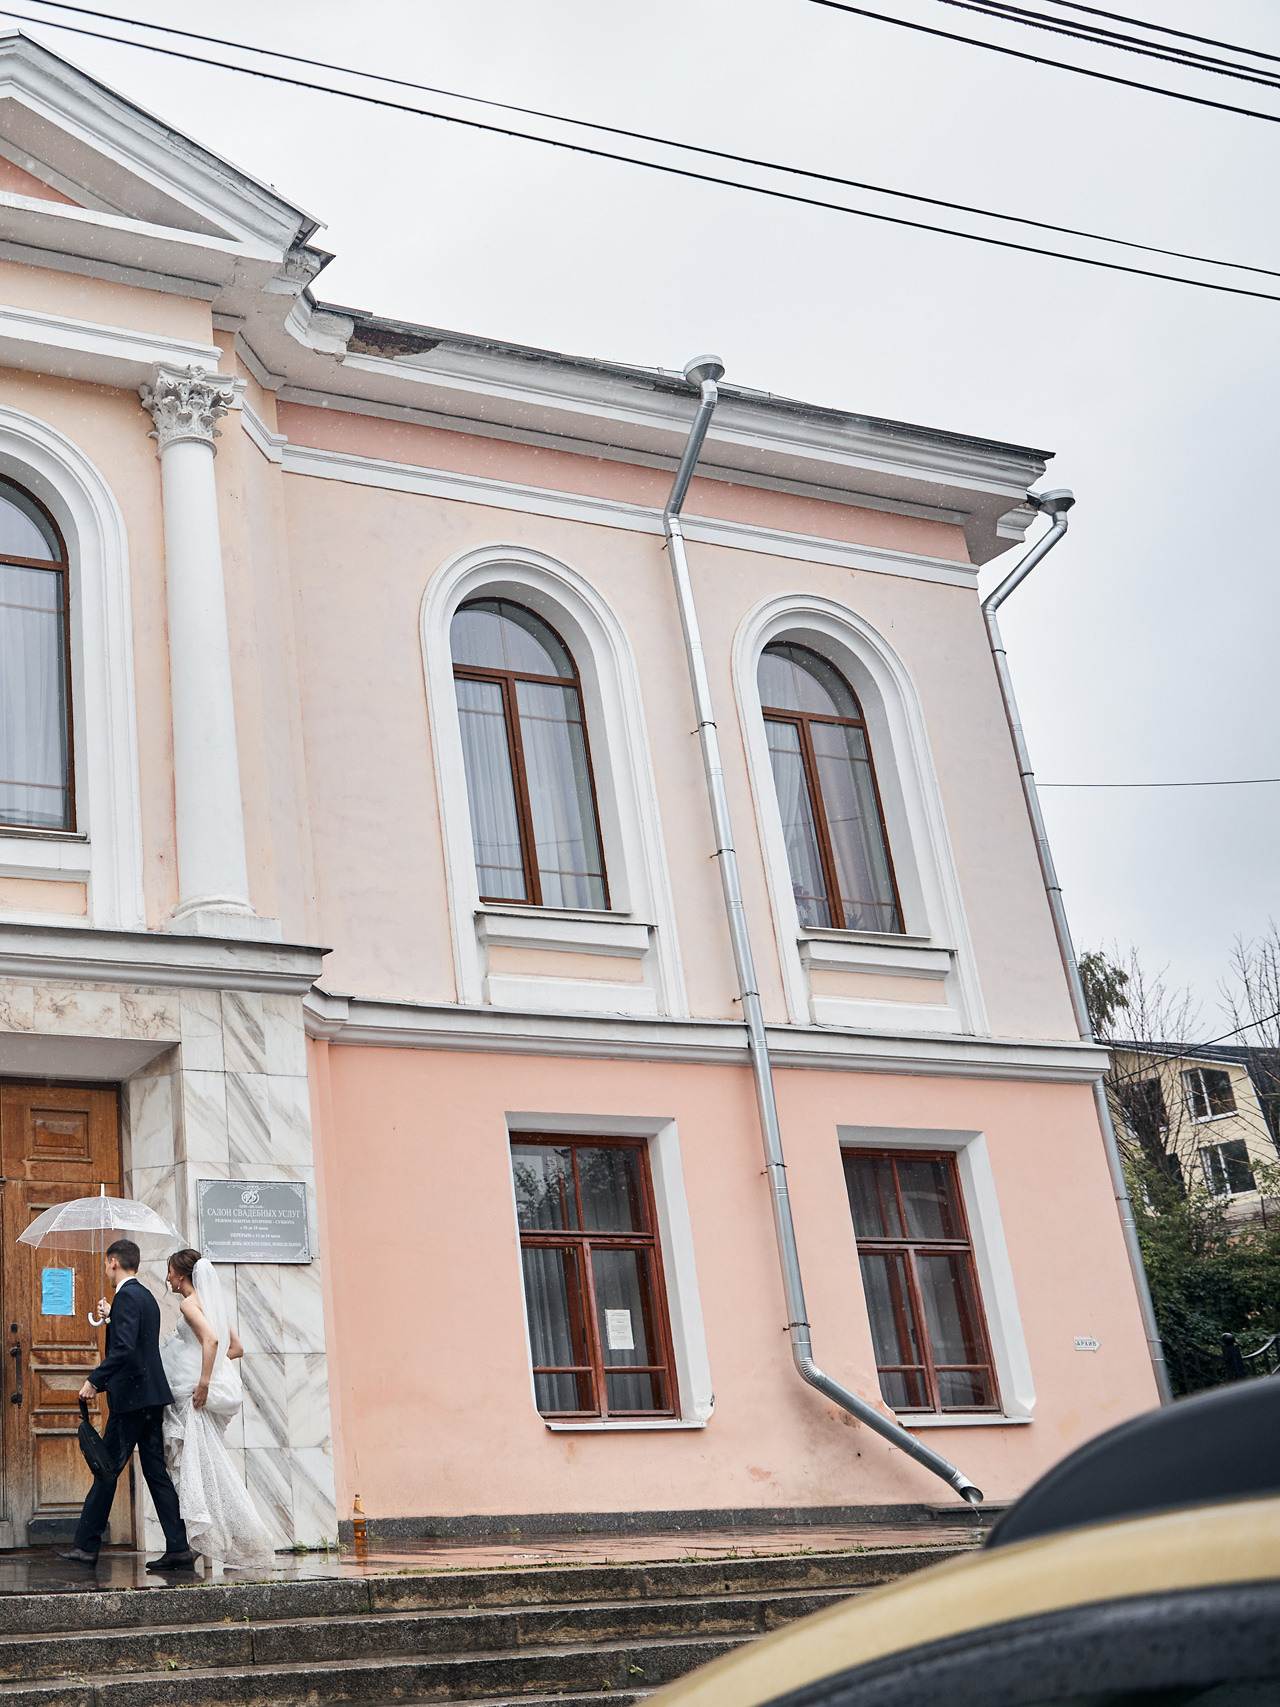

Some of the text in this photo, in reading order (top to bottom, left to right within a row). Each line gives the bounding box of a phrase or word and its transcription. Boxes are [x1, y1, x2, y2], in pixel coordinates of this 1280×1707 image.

[207, 1208, 300, 1218] САЛОН СВАДЕБНЫХ УСЛУГ
